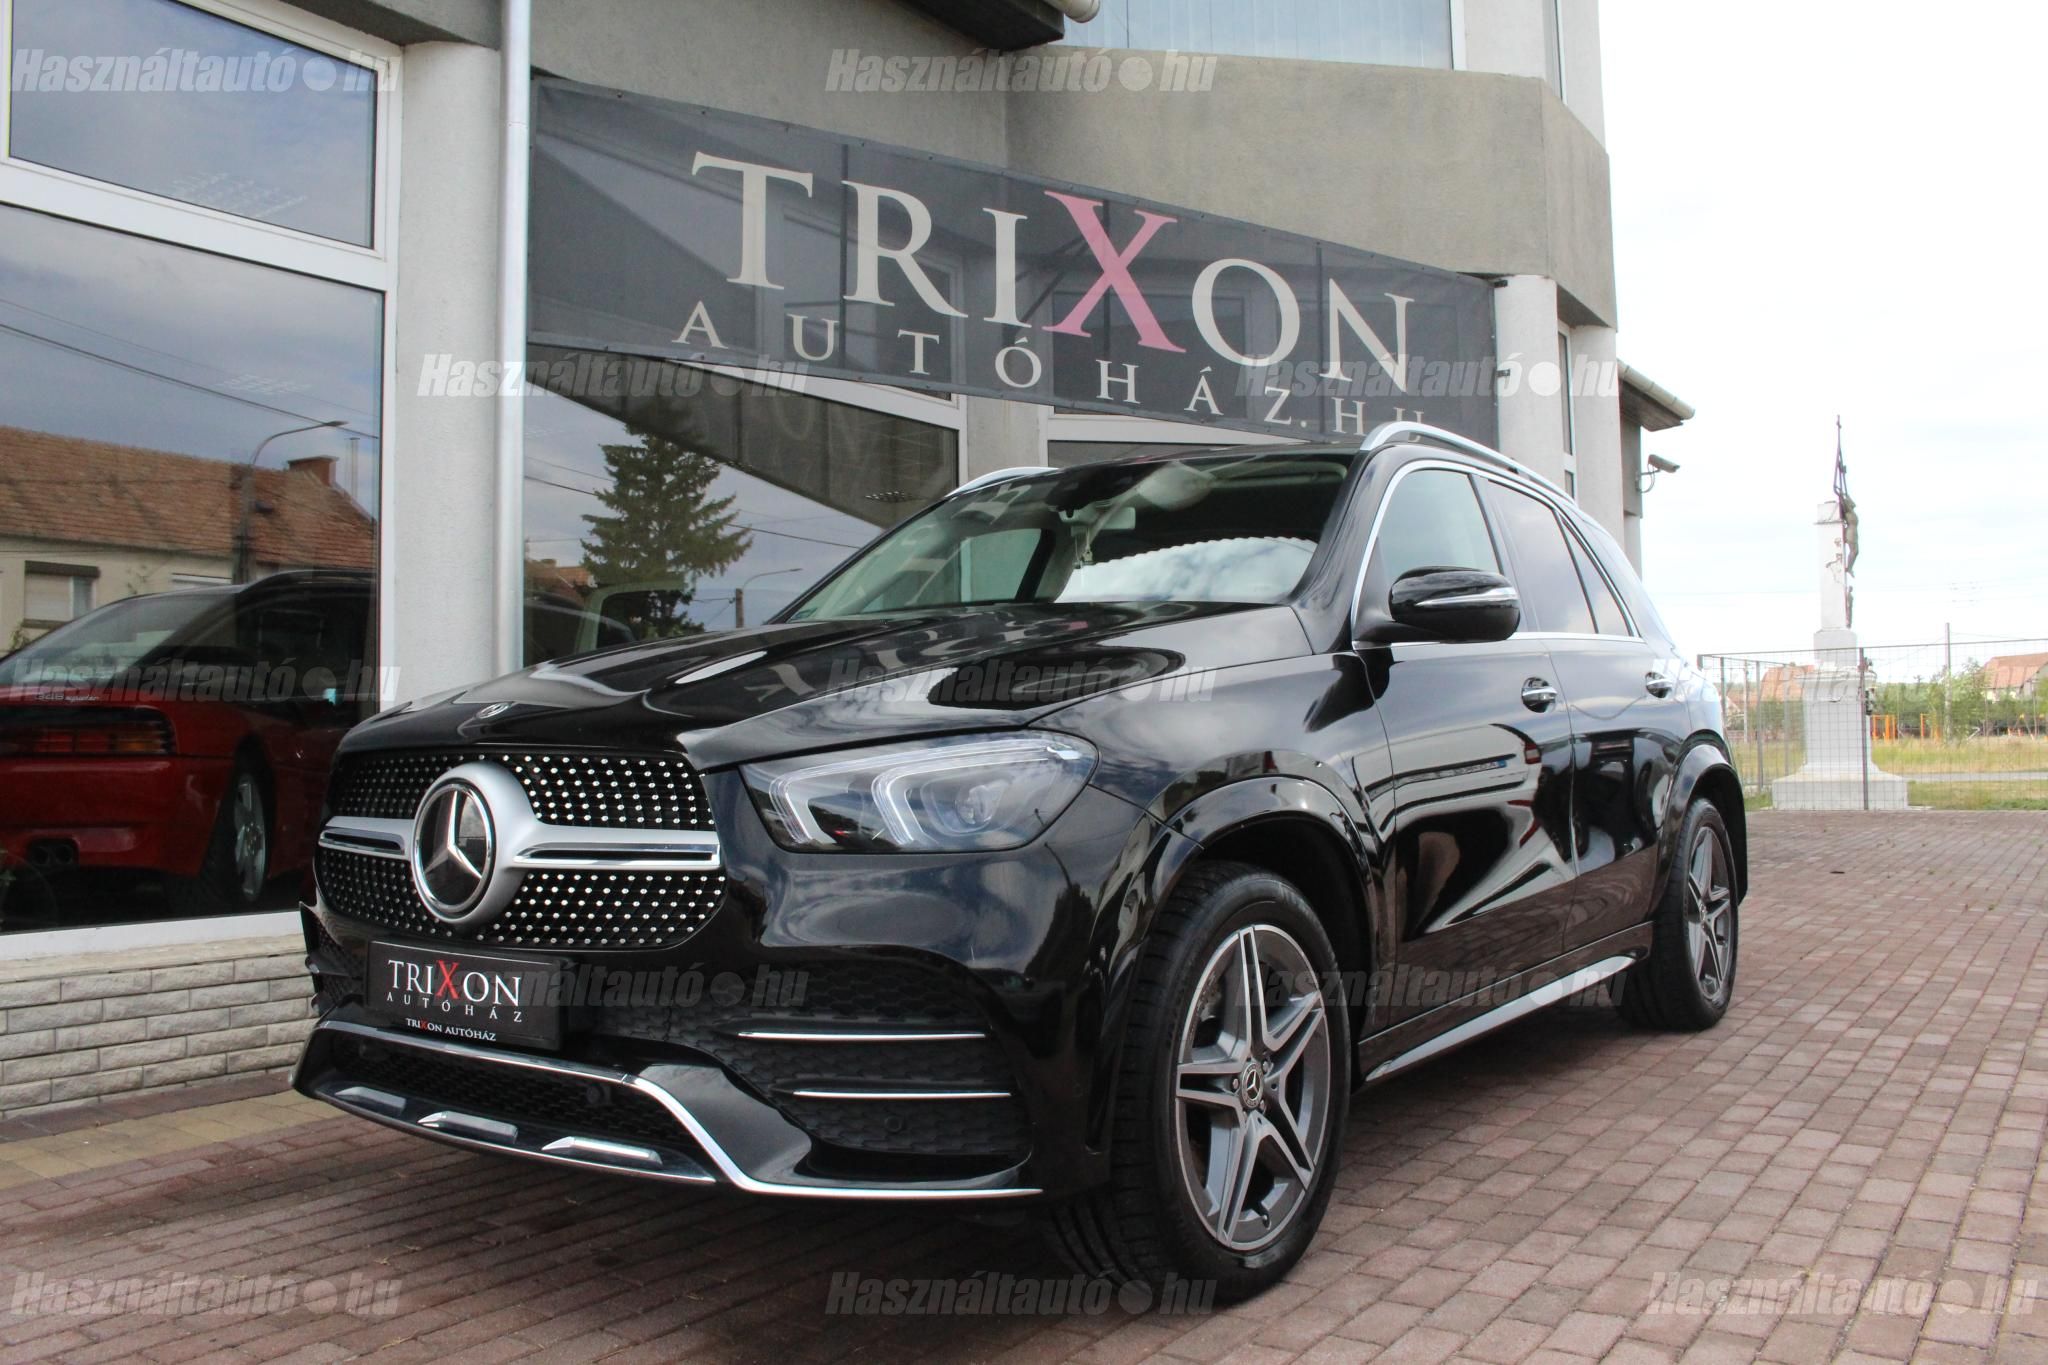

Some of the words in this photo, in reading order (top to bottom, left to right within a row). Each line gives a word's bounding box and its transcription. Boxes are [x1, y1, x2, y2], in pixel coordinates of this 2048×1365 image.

[691, 151, 1415, 393] TRIXON
[387, 958, 522, 1008] TRIXON
[386, 991, 523, 1023] AUTÓHÁZ
[405, 1017, 442, 1034] TRIXON
[445, 1025, 497, 1042] AUTÓHÁZ
